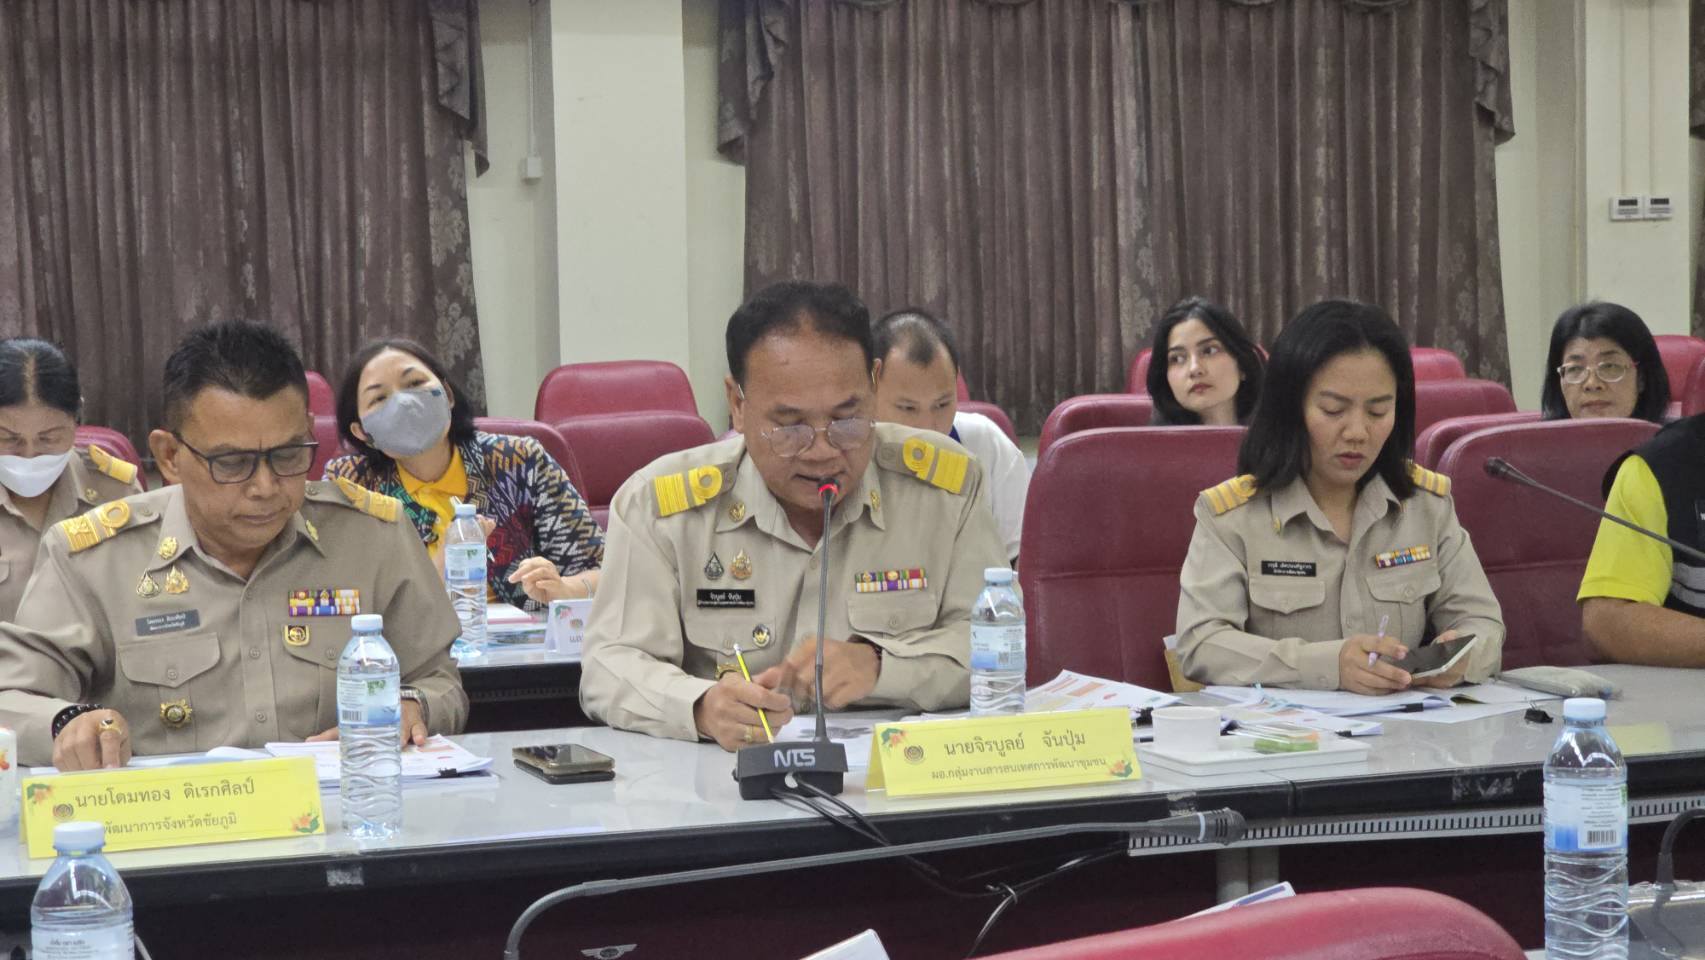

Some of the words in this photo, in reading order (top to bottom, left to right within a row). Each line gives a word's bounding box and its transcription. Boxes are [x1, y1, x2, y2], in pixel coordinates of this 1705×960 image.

[944, 732, 1025, 757] นายจิรบูลย์
[1042, 729, 1086, 751] จันปุ่ม
[773, 748, 816, 768] NTS
[75, 787, 171, 808] นายโดมทอง
[183, 777, 255, 799] ดิเรกศิลป์
